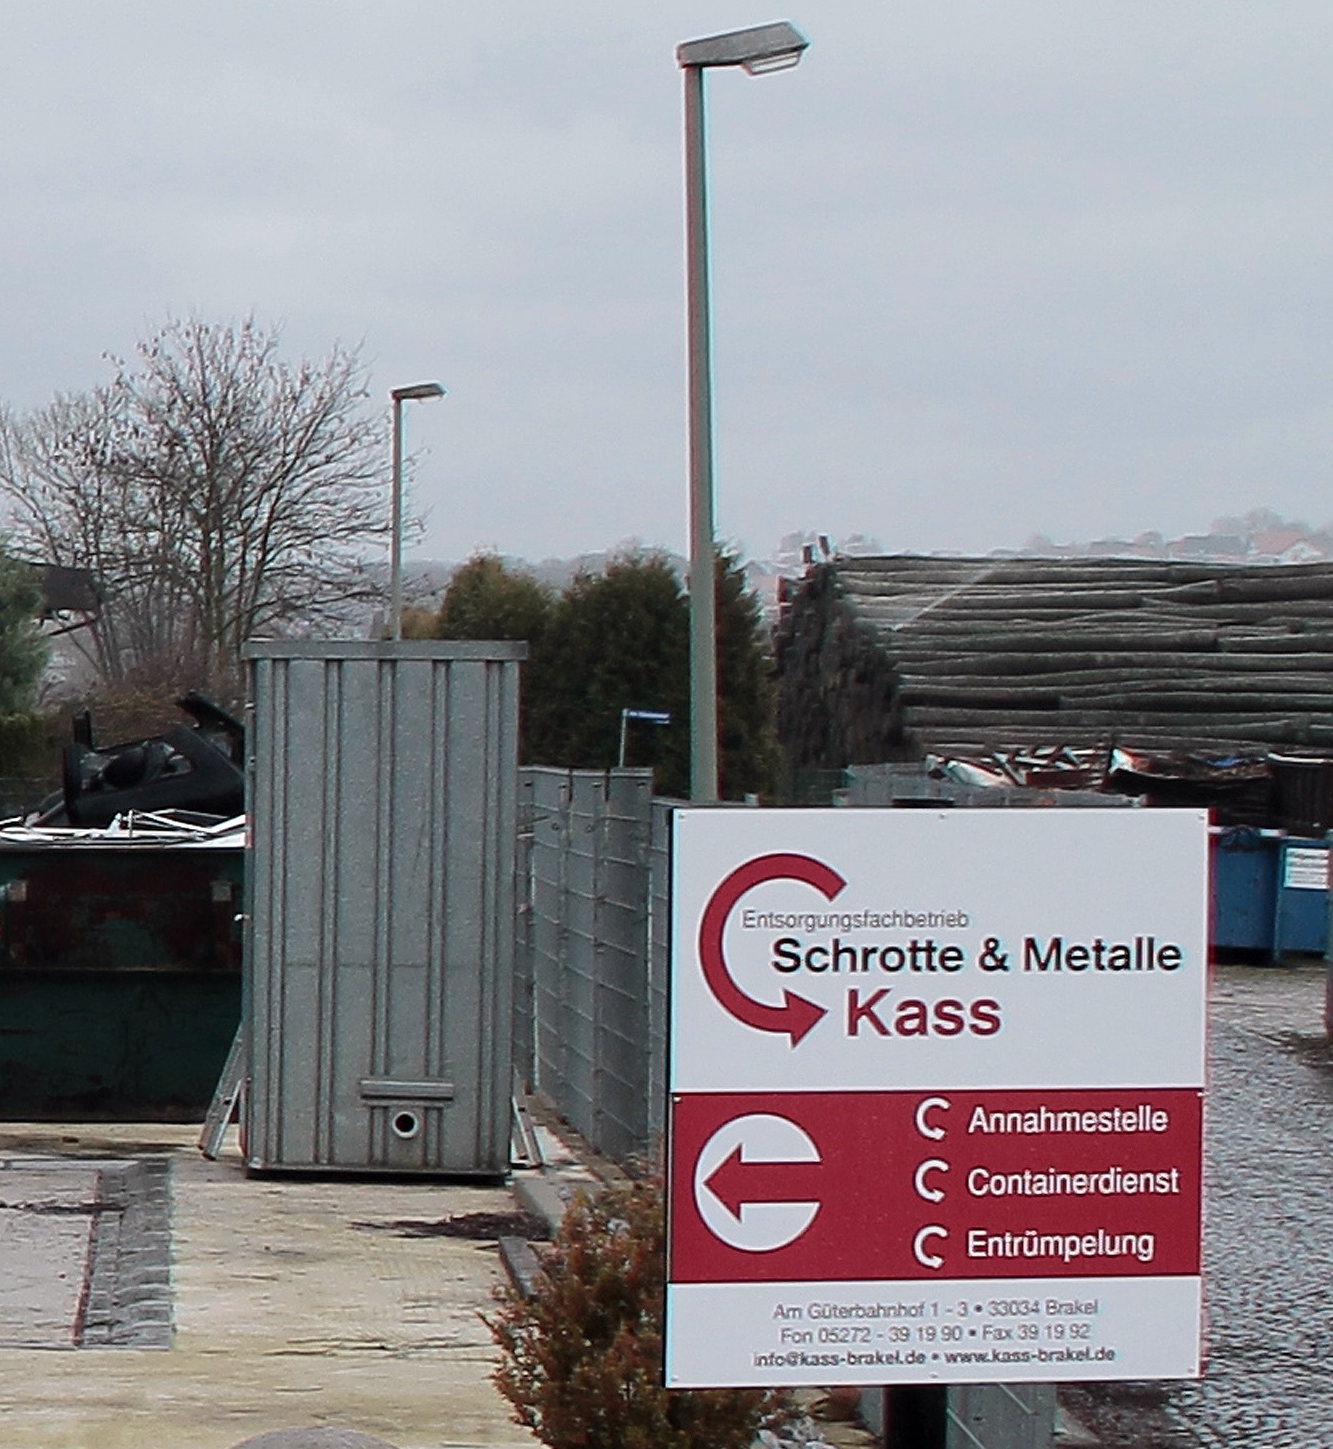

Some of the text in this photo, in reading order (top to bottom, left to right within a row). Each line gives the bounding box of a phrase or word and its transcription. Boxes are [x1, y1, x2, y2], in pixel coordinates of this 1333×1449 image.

[741, 908, 970, 933] Entsorgungsfachbetrieb
[770, 936, 1183, 974] Schrotte & Metalle
[845, 987, 1003, 1038] Kass
[967, 1104, 1170, 1134] Annahmestelle
[966, 1166, 1181, 1196] Containerdienst
[966, 1228, 1156, 1263] Entrümpelung
[772, 1303, 803, 1320] Am
[807, 1301, 926, 1320] Güterbahnhof
[930, 1302, 939, 1317] 1
[957, 1301, 969, 1317] 3
[987, 1300, 1041, 1317] 33034
[1045, 1299, 1099, 1316] Brakel
[780, 1327, 814, 1344] Fon
[817, 1326, 872, 1344] 05272
[887, 1326, 910, 1343] 39
[916, 1325, 937, 1342] 19
[940, 1325, 963, 1342] 90
[982, 1324, 1014, 1341] Fax
[1017, 1323, 1039, 1340] 39
[1045, 1323, 1065, 1340] 19
[1068, 1322, 1092, 1340] 92
[753, 1345, 1116, 1367] info@kass-brakel.de www.kass-brakel.de
